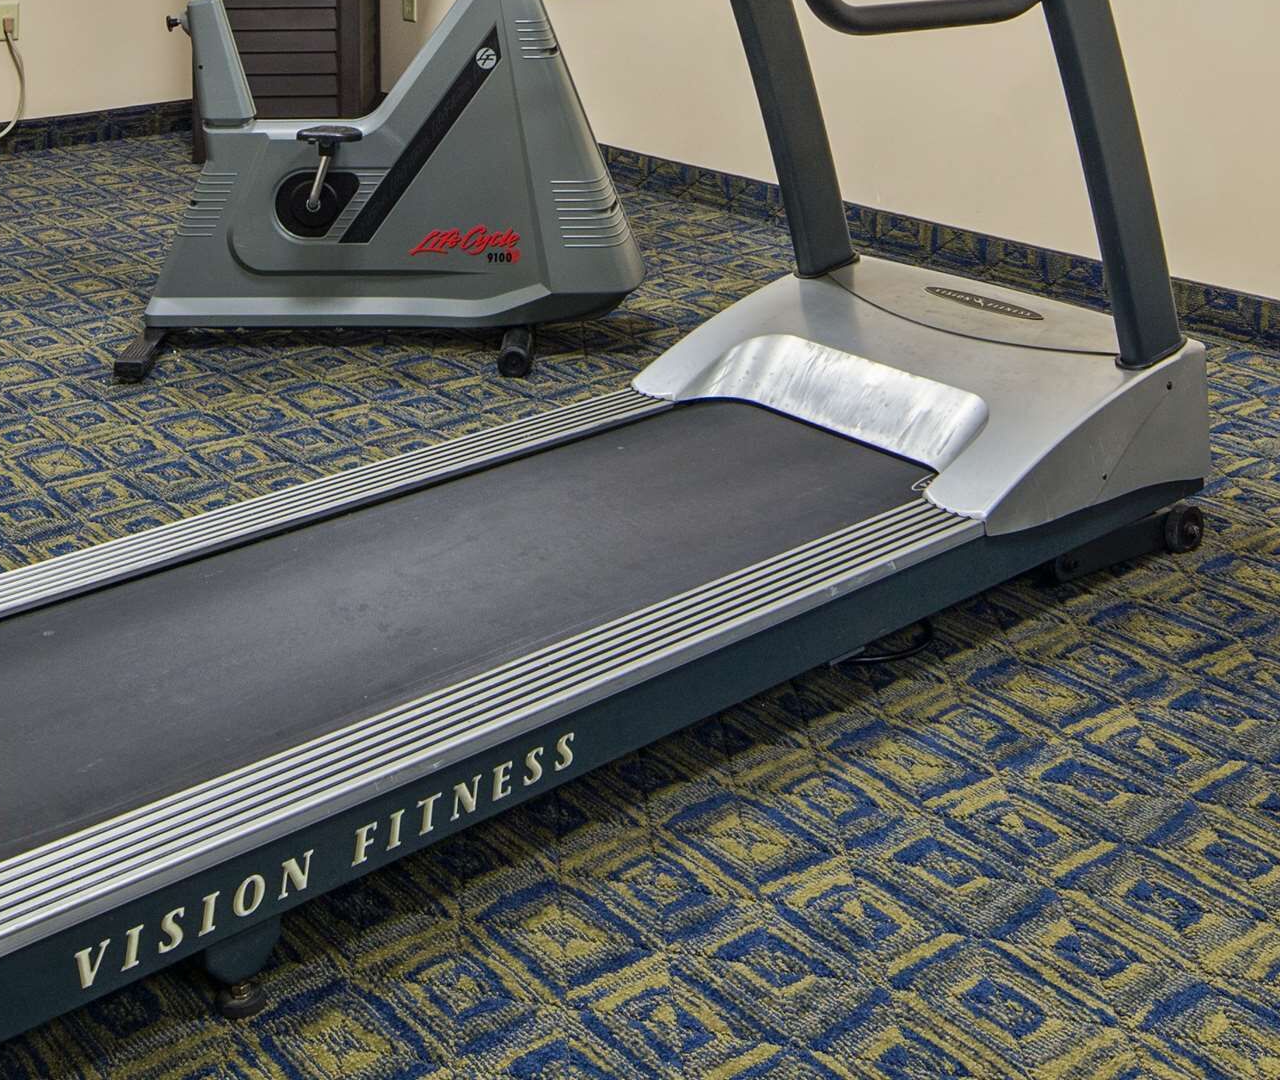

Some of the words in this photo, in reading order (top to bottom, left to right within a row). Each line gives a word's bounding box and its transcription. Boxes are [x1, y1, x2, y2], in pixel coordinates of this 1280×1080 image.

[486, 251, 513, 263] 9100
[73, 848, 314, 990] VISION
[351, 731, 577, 869] FITNESS
